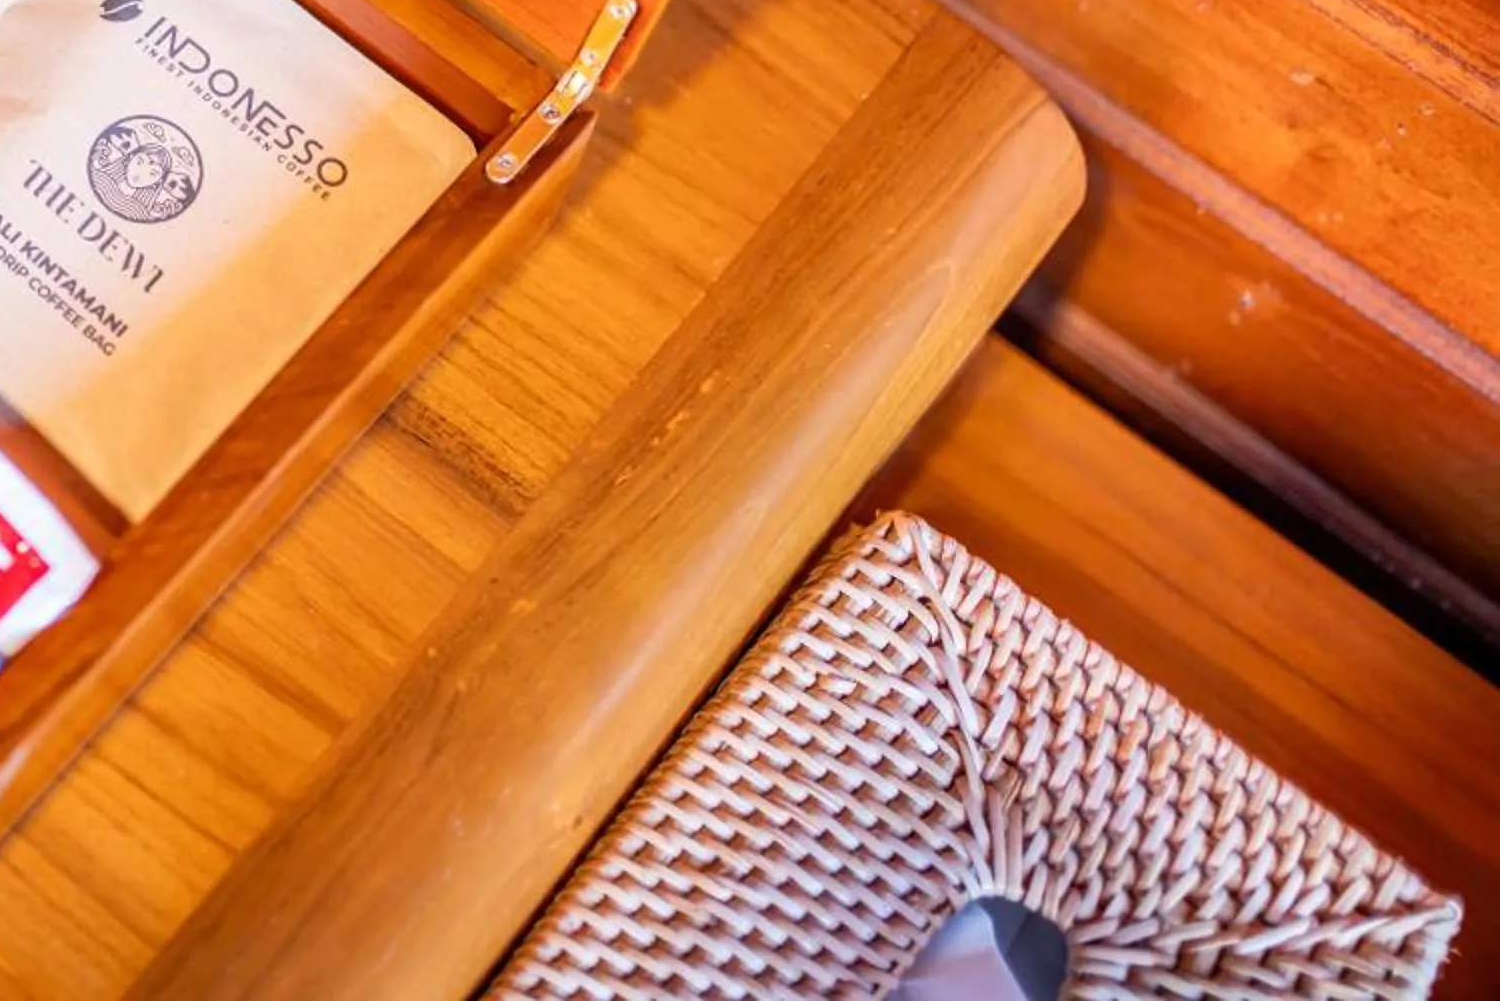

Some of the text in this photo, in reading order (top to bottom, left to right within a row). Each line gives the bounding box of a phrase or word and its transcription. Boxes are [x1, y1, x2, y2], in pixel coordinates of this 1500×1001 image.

[135, 37, 331, 201] FINEST INDONESIAN COFFEE
[144, 16, 348, 187] INDONESSO
[20, 239, 130, 338] KINTAMANI
[22, 159, 164, 294] THE DEWI
[28, 276, 85, 329] COFFEE
[82, 324, 117, 356] BAG
